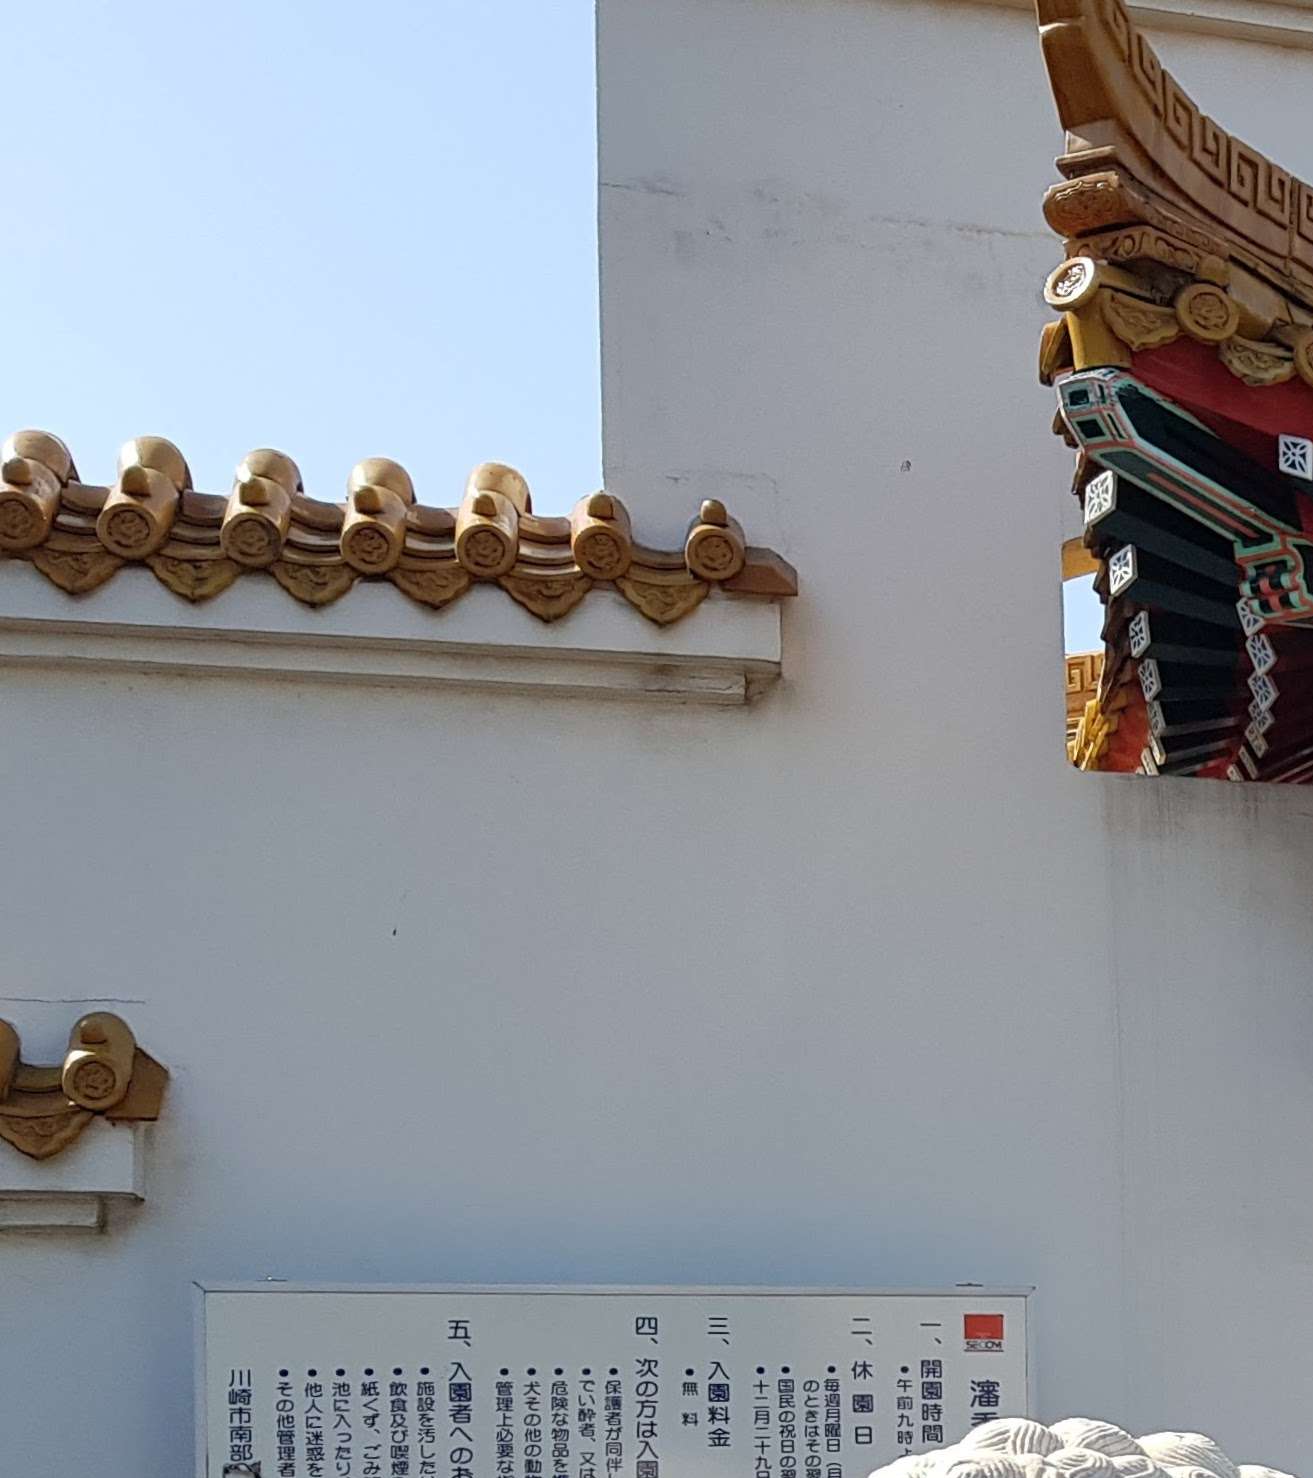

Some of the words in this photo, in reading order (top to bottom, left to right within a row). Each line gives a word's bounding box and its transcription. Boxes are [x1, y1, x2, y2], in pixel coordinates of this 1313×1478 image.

[228, 1369, 253, 1462] 川崎市南部
[681, 1382, 698, 1426] 無料
[707, 1317, 731, 1447] 三、入園料金
[920, 1323, 943, 1443] 一、開園時間
